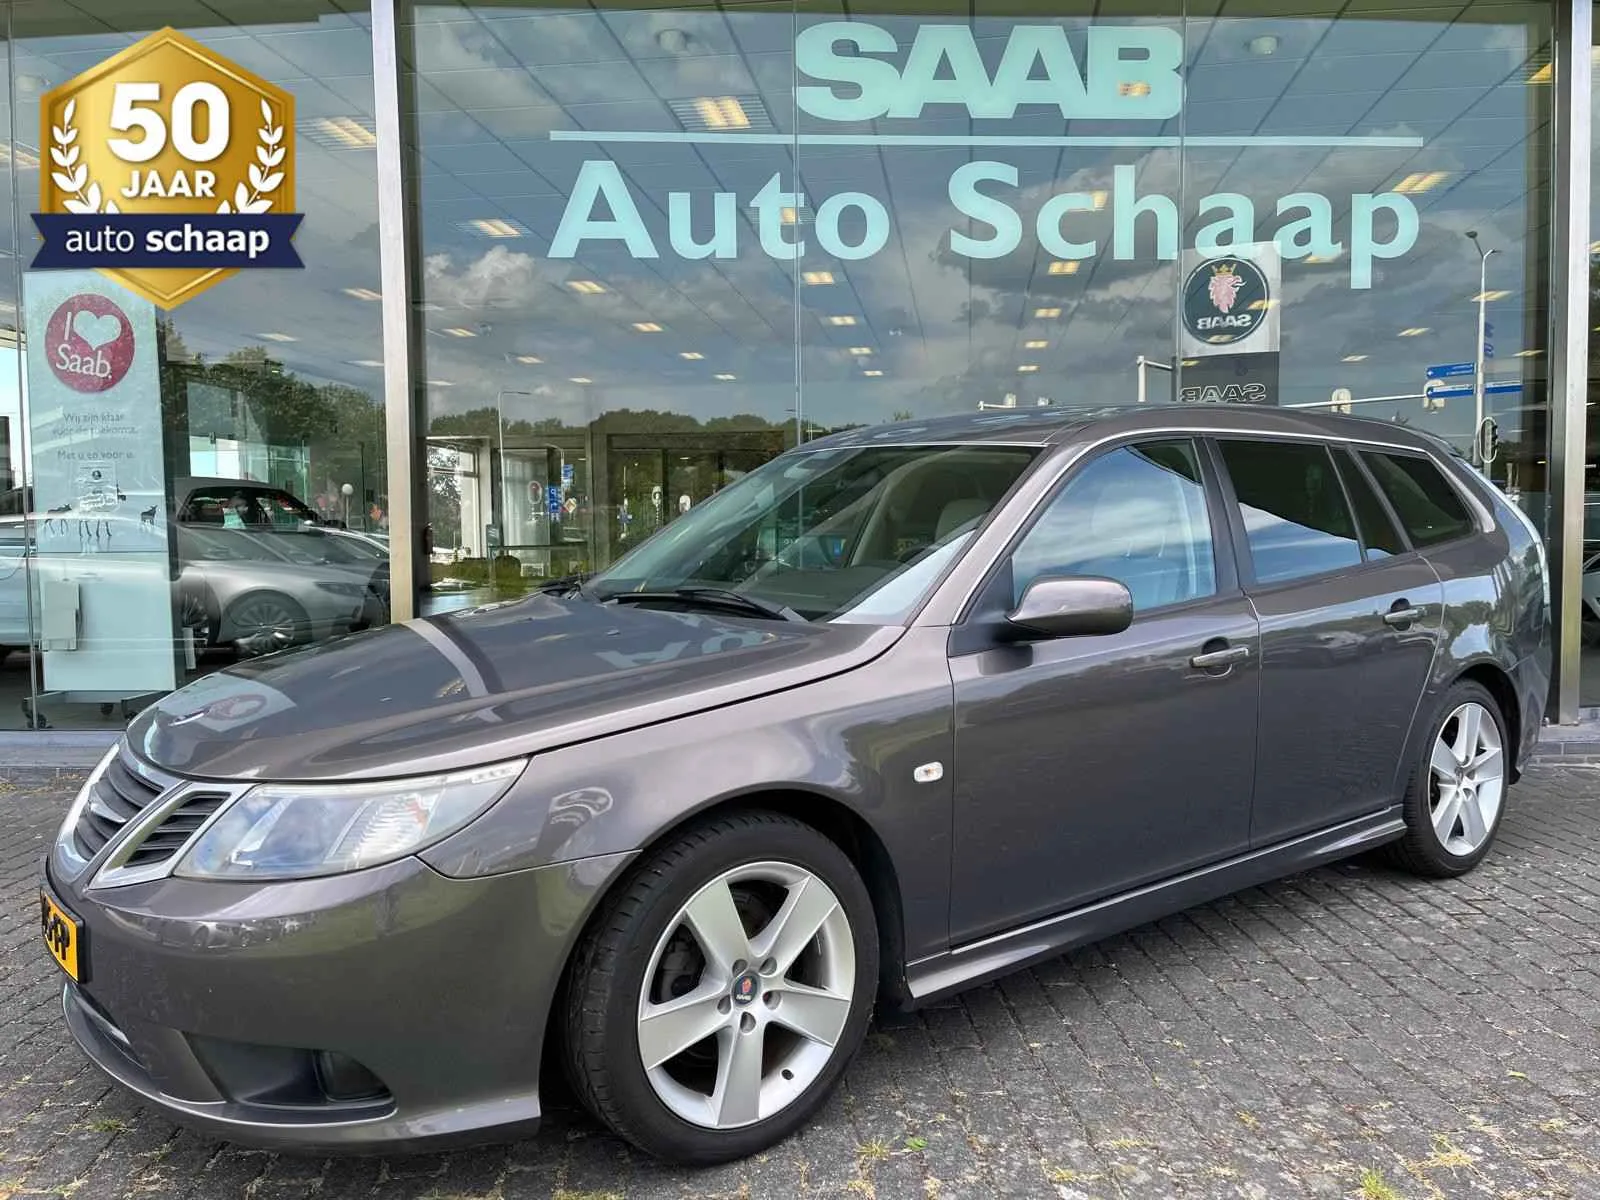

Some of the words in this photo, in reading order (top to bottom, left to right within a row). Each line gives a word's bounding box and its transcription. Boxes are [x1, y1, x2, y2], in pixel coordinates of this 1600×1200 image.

[795, 22, 1184, 121] SAAB
[547, 160, 890, 260] Auto
[948, 160, 1420, 290] Schaap
